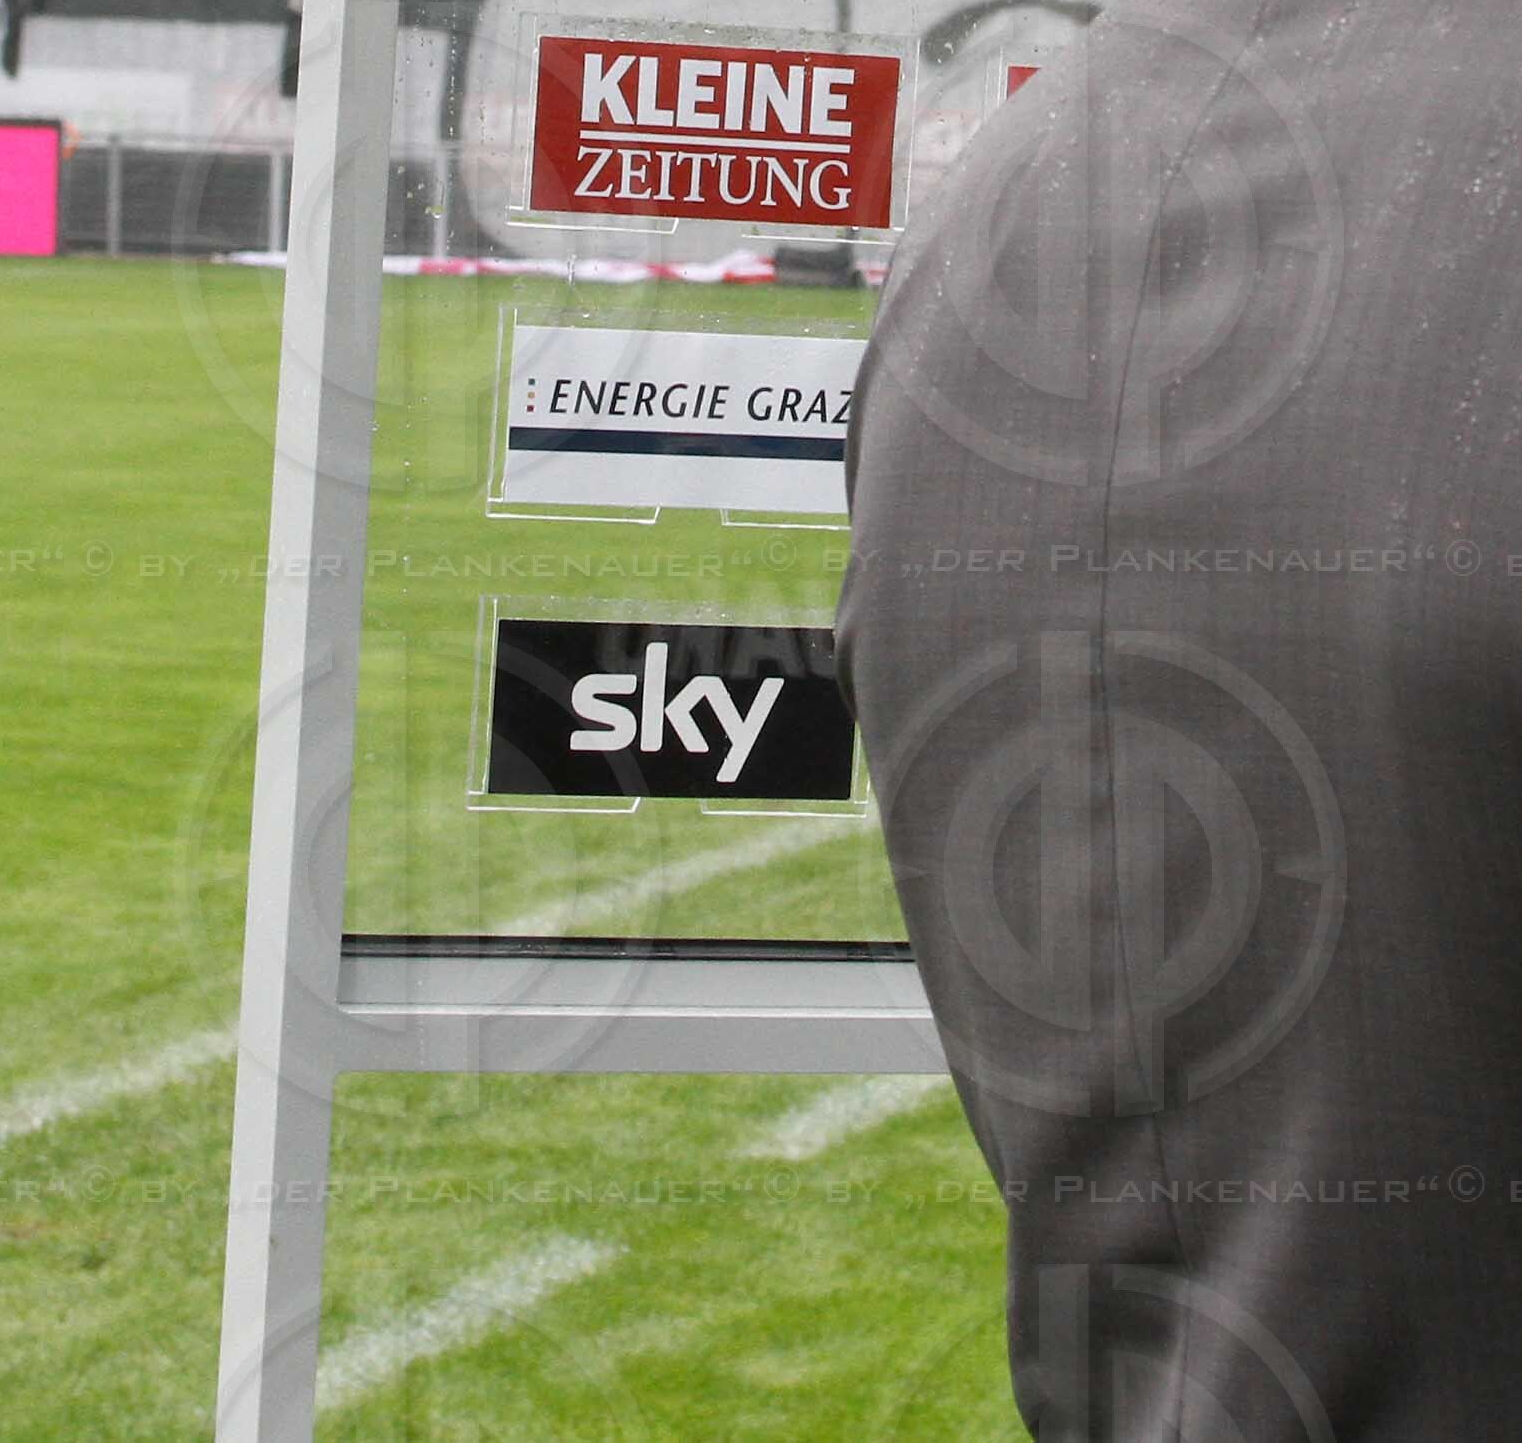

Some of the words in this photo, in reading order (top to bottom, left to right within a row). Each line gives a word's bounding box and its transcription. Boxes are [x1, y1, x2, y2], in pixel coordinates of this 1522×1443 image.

[581, 53, 855, 137] KLEINE
[574, 145, 852, 210] ZEITUNG
[549, 378, 730, 420] ENERGIE
[569, 641, 785, 783] sky
